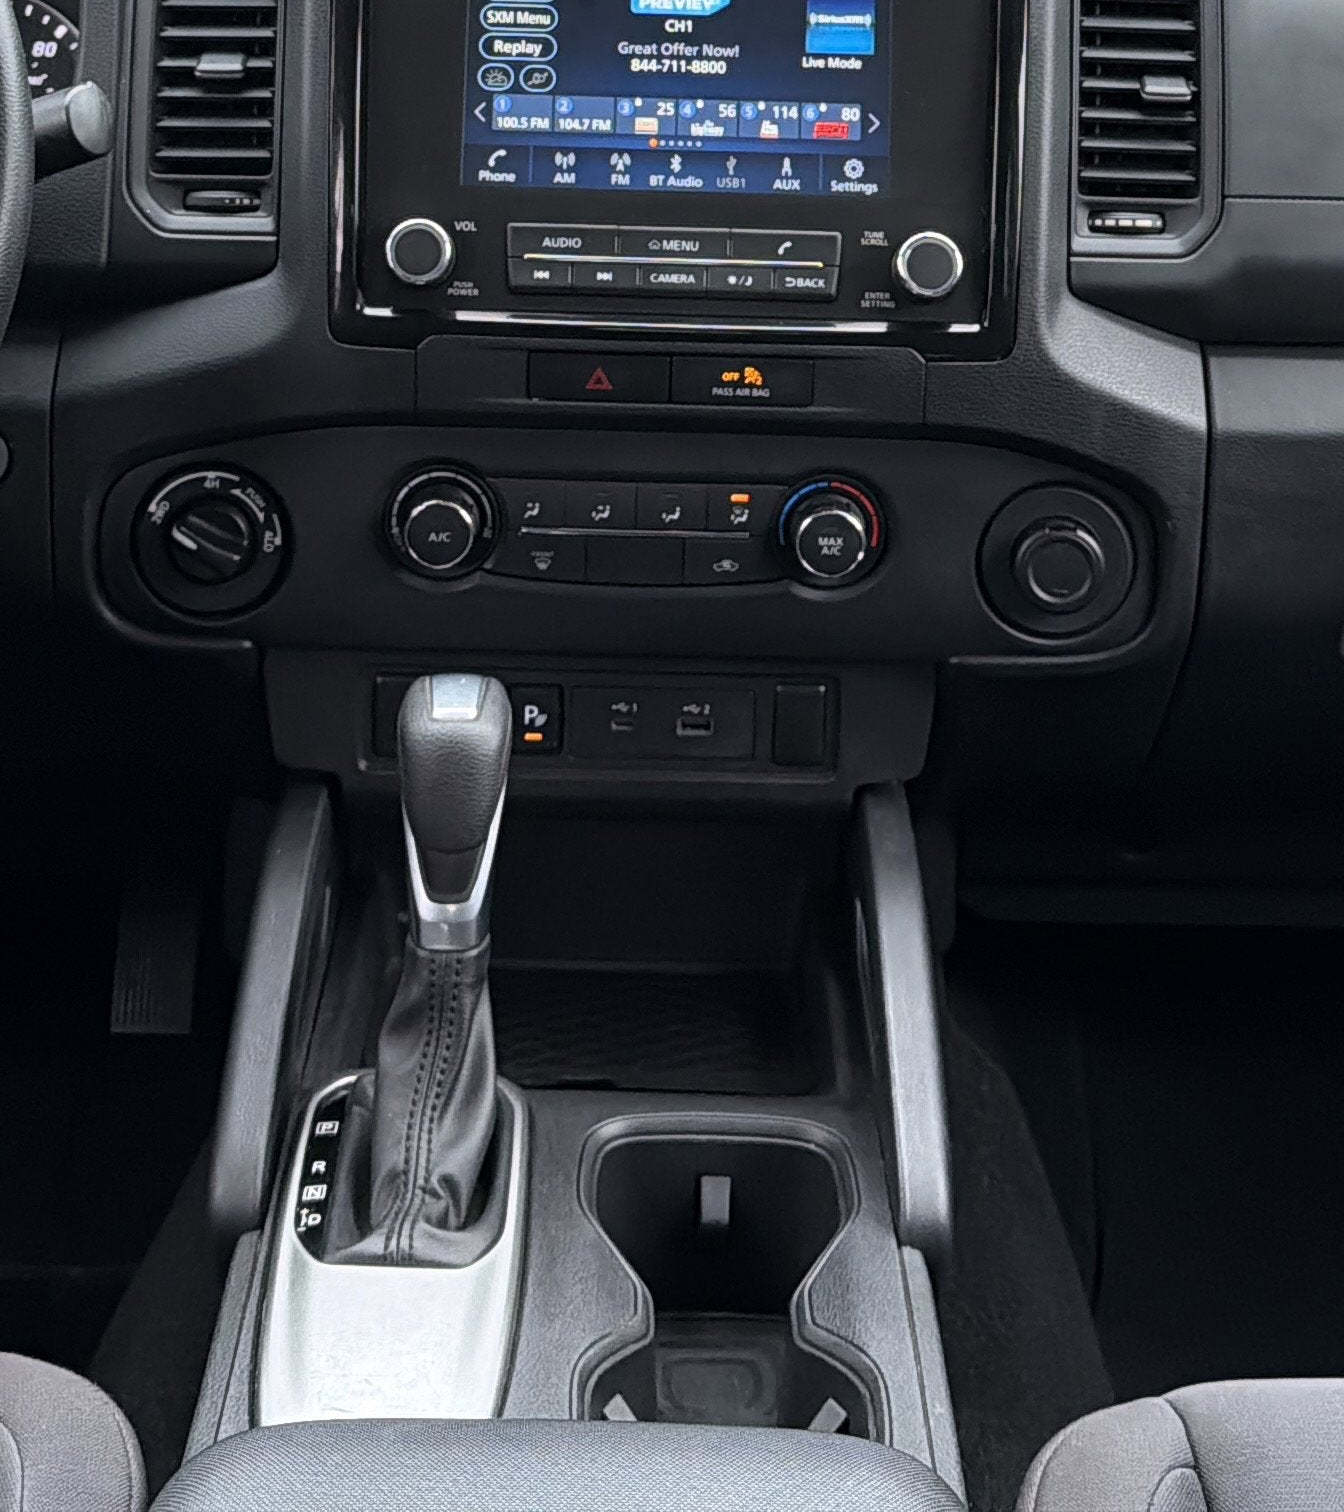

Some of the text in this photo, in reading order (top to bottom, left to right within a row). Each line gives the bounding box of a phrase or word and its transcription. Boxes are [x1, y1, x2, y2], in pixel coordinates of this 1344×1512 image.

[486, 11, 551, 25] SXM Menu
[664, 19, 693, 33] CH1
[31, 41, 58, 58] 80
[493, 39, 543, 57] Replay
[618, 41, 739, 58] Great Offer Now!
[630, 59, 726, 75] 844-711-8800
[802, 56, 863, 70] Live Mode
[657, 102, 675, 115] 25
[718, 104, 737, 118] 56
[772, 105, 799, 119] 114
[841, 107, 860, 121] 80
[496, 117, 550, 129] 100.5 FM
[558, 118, 611, 131] 104.7 FM
[478, 170, 516, 183] Phone
[553, 172, 576, 184] AM
[610, 173, 630, 186] FM
[649, 174, 703, 188] BT Audio
[717, 177, 745, 188] USB1
[772, 178, 800, 190] AUX
[830, 180, 878, 196] Settings
[454, 221, 477, 232] VOL
[864, 231, 885, 239] TUNE
[542, 237, 582, 248] AUDIO
[662, 240, 699, 251] MENU
[860, 238, 889, 246] SCROLL
[650, 273, 695, 284] CAMERA
[796, 278, 826, 288] BACK
[447, 288, 479, 296] POWER
[864, 292, 890, 300] ENTER
[860, 300, 895, 309] SETTING
[722, 371, 740, 381] OFF
[712, 387, 770, 397] PASS AIR BAG
[204, 479, 220, 488] 4H
[428, 532, 452, 542] A/C
[818, 537, 843, 546] MAX
[821, 546, 841, 556] A/C
[524, 705, 539, 725] P
[311, 1160, 327, 1175] R
[307, 1213, 322, 1226] D
